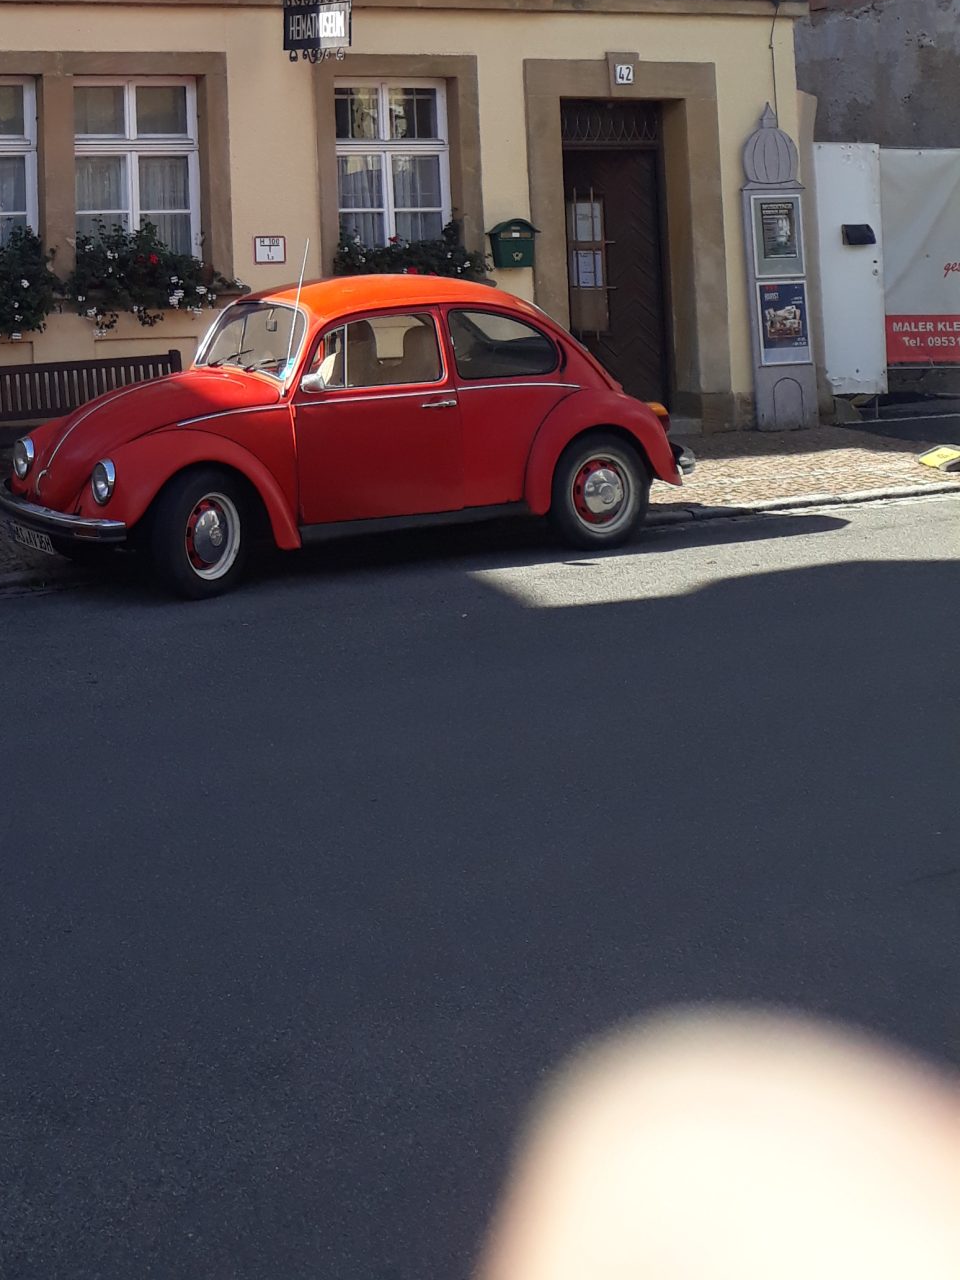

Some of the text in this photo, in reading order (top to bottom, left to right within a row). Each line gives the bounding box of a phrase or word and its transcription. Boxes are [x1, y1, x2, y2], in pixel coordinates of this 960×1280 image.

[618, 66, 632, 81] 42
[892, 321, 934, 332] MALER
[902, 336, 960, 347] Tel. 09531
